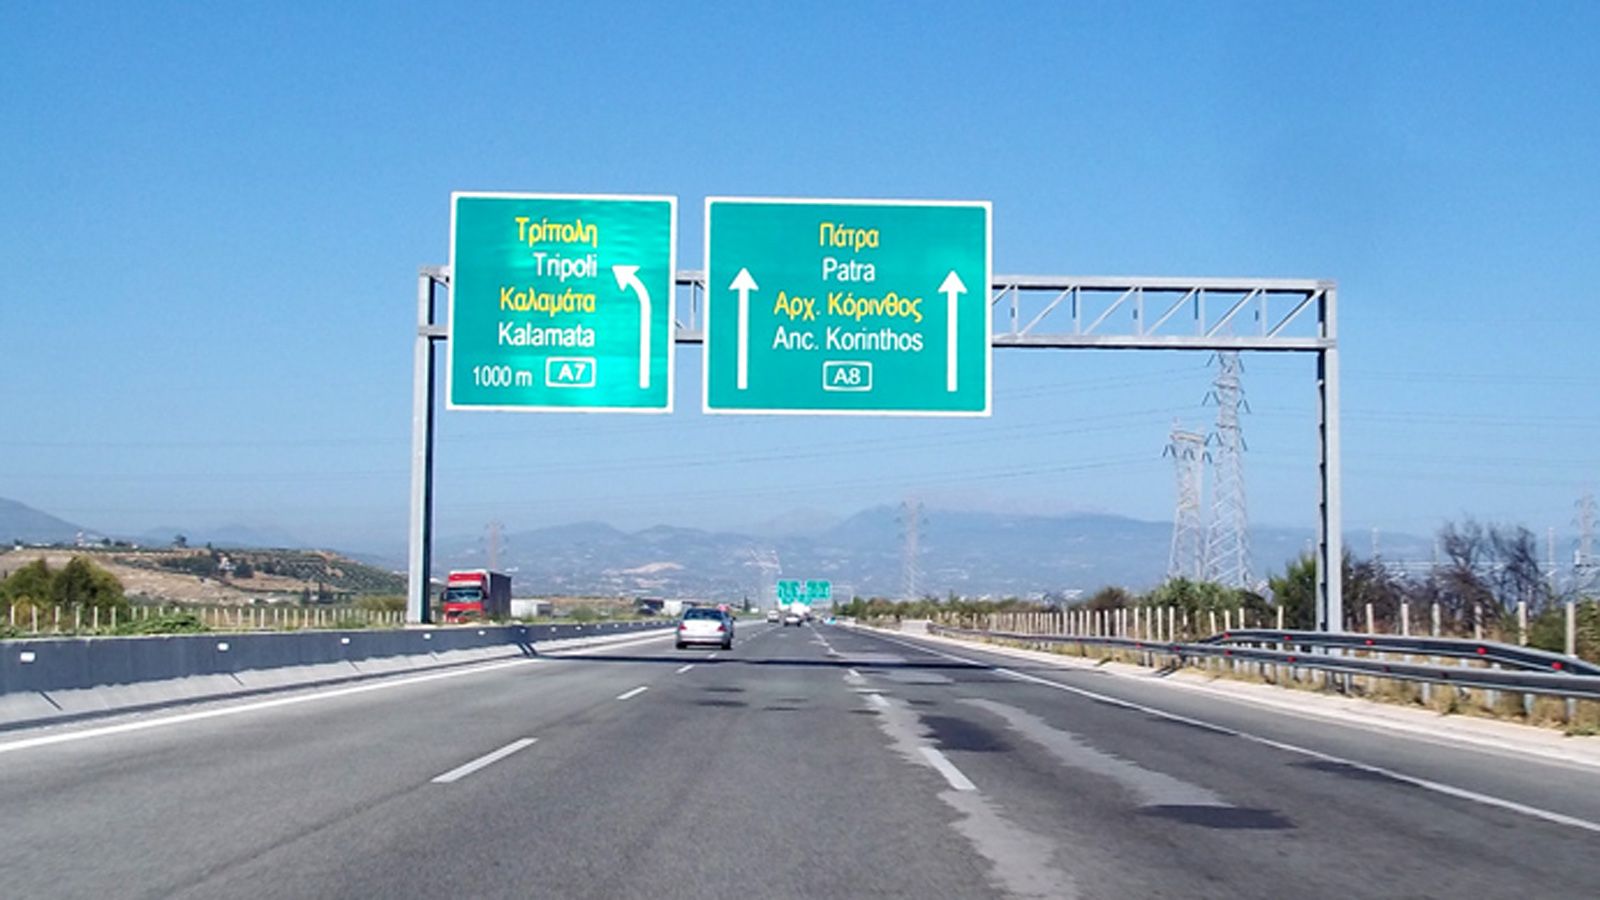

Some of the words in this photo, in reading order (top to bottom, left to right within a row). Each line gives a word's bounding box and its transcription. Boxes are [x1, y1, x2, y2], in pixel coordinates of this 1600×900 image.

[515, 217, 597, 248] Τρίπολη
[819, 222, 879, 252] Πάτρα
[533, 252, 597, 282] Tripoli
[822, 257, 875, 282] Patra
[500, 287, 596, 317] Καλαμάτα
[773, 291, 821, 321] Αρχ.
[828, 292, 923, 322] Κόρινθος
[498, 322, 595, 347] Kalamata
[772, 325, 819, 351] Anc.
[826, 326, 924, 351] Korinthos
[473, 365, 511, 387] 1000
[515, 370, 533, 387] m
[558, 364, 586, 381] A7
[833, 367, 861, 384] A8
